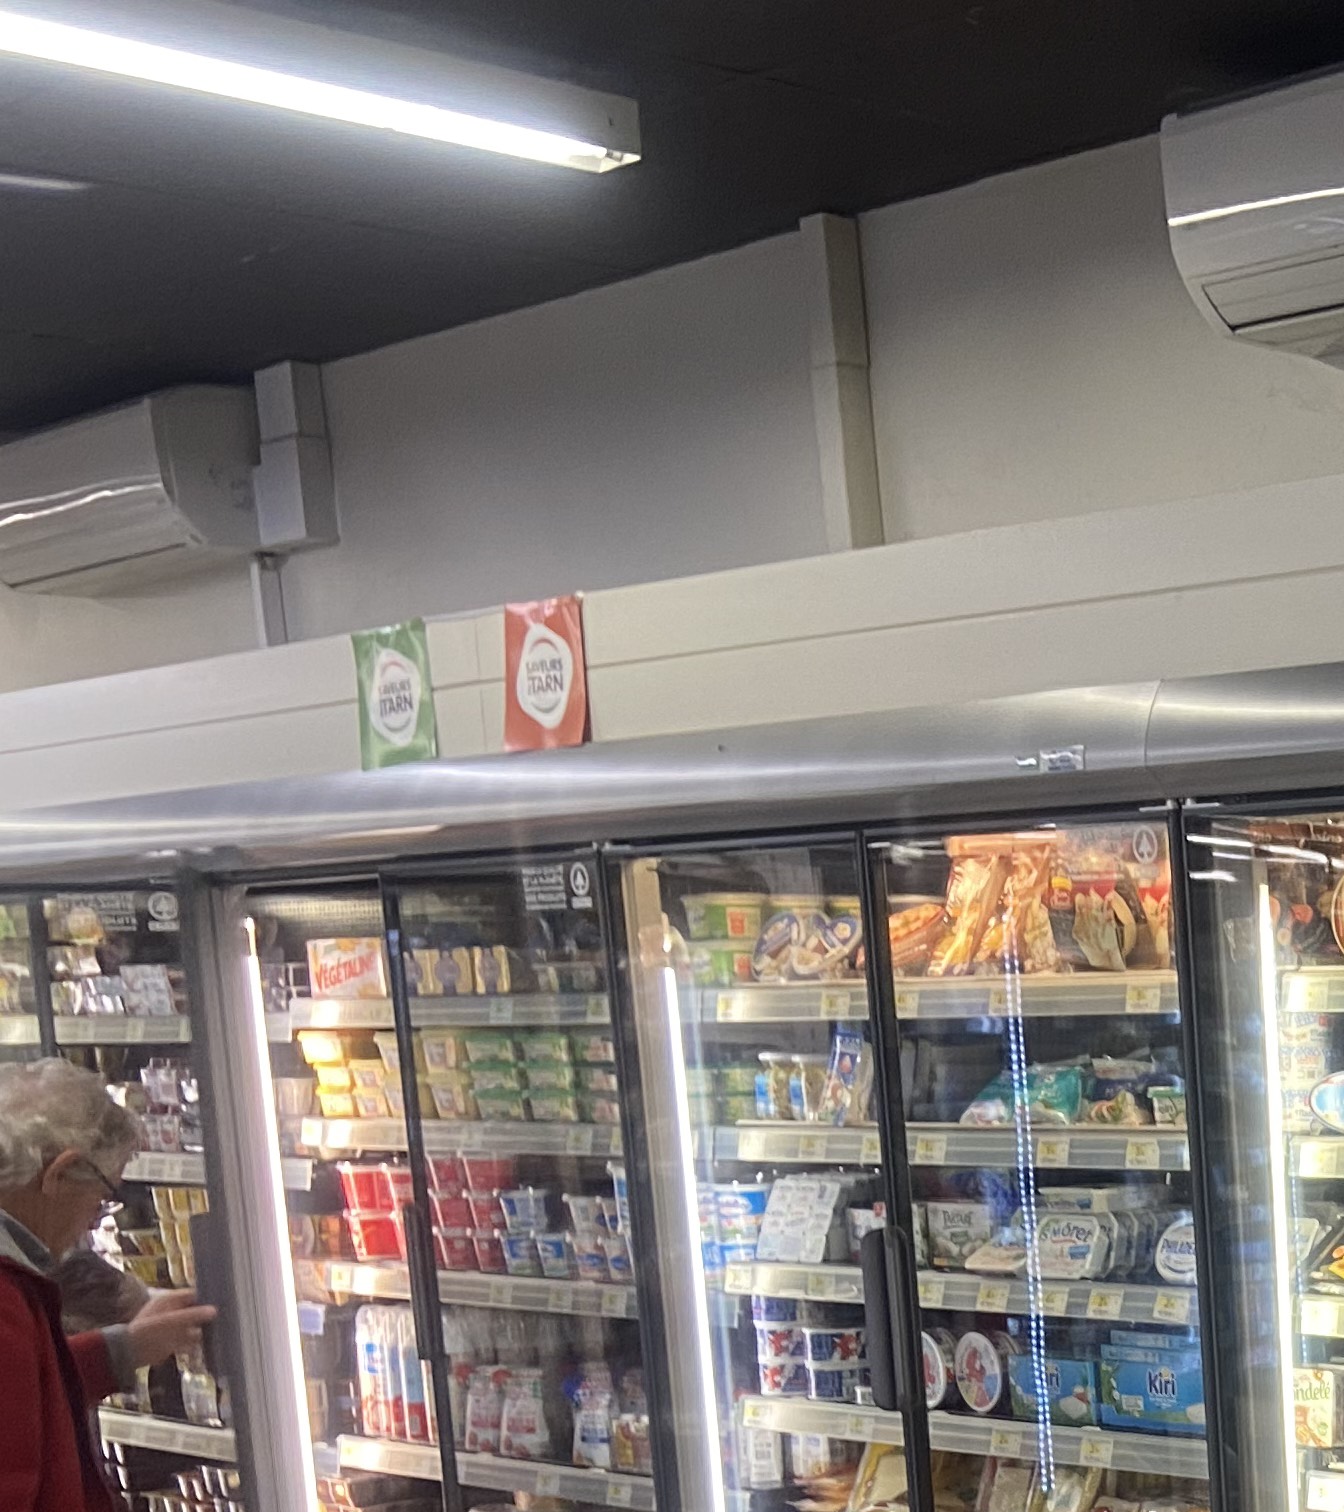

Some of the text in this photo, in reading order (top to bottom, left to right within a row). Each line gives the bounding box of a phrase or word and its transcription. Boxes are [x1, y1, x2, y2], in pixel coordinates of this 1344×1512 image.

[527, 674, 564, 696] TARN
[380, 693, 414, 716] TARN
[1146, 1369, 1176, 1395] Kiri
